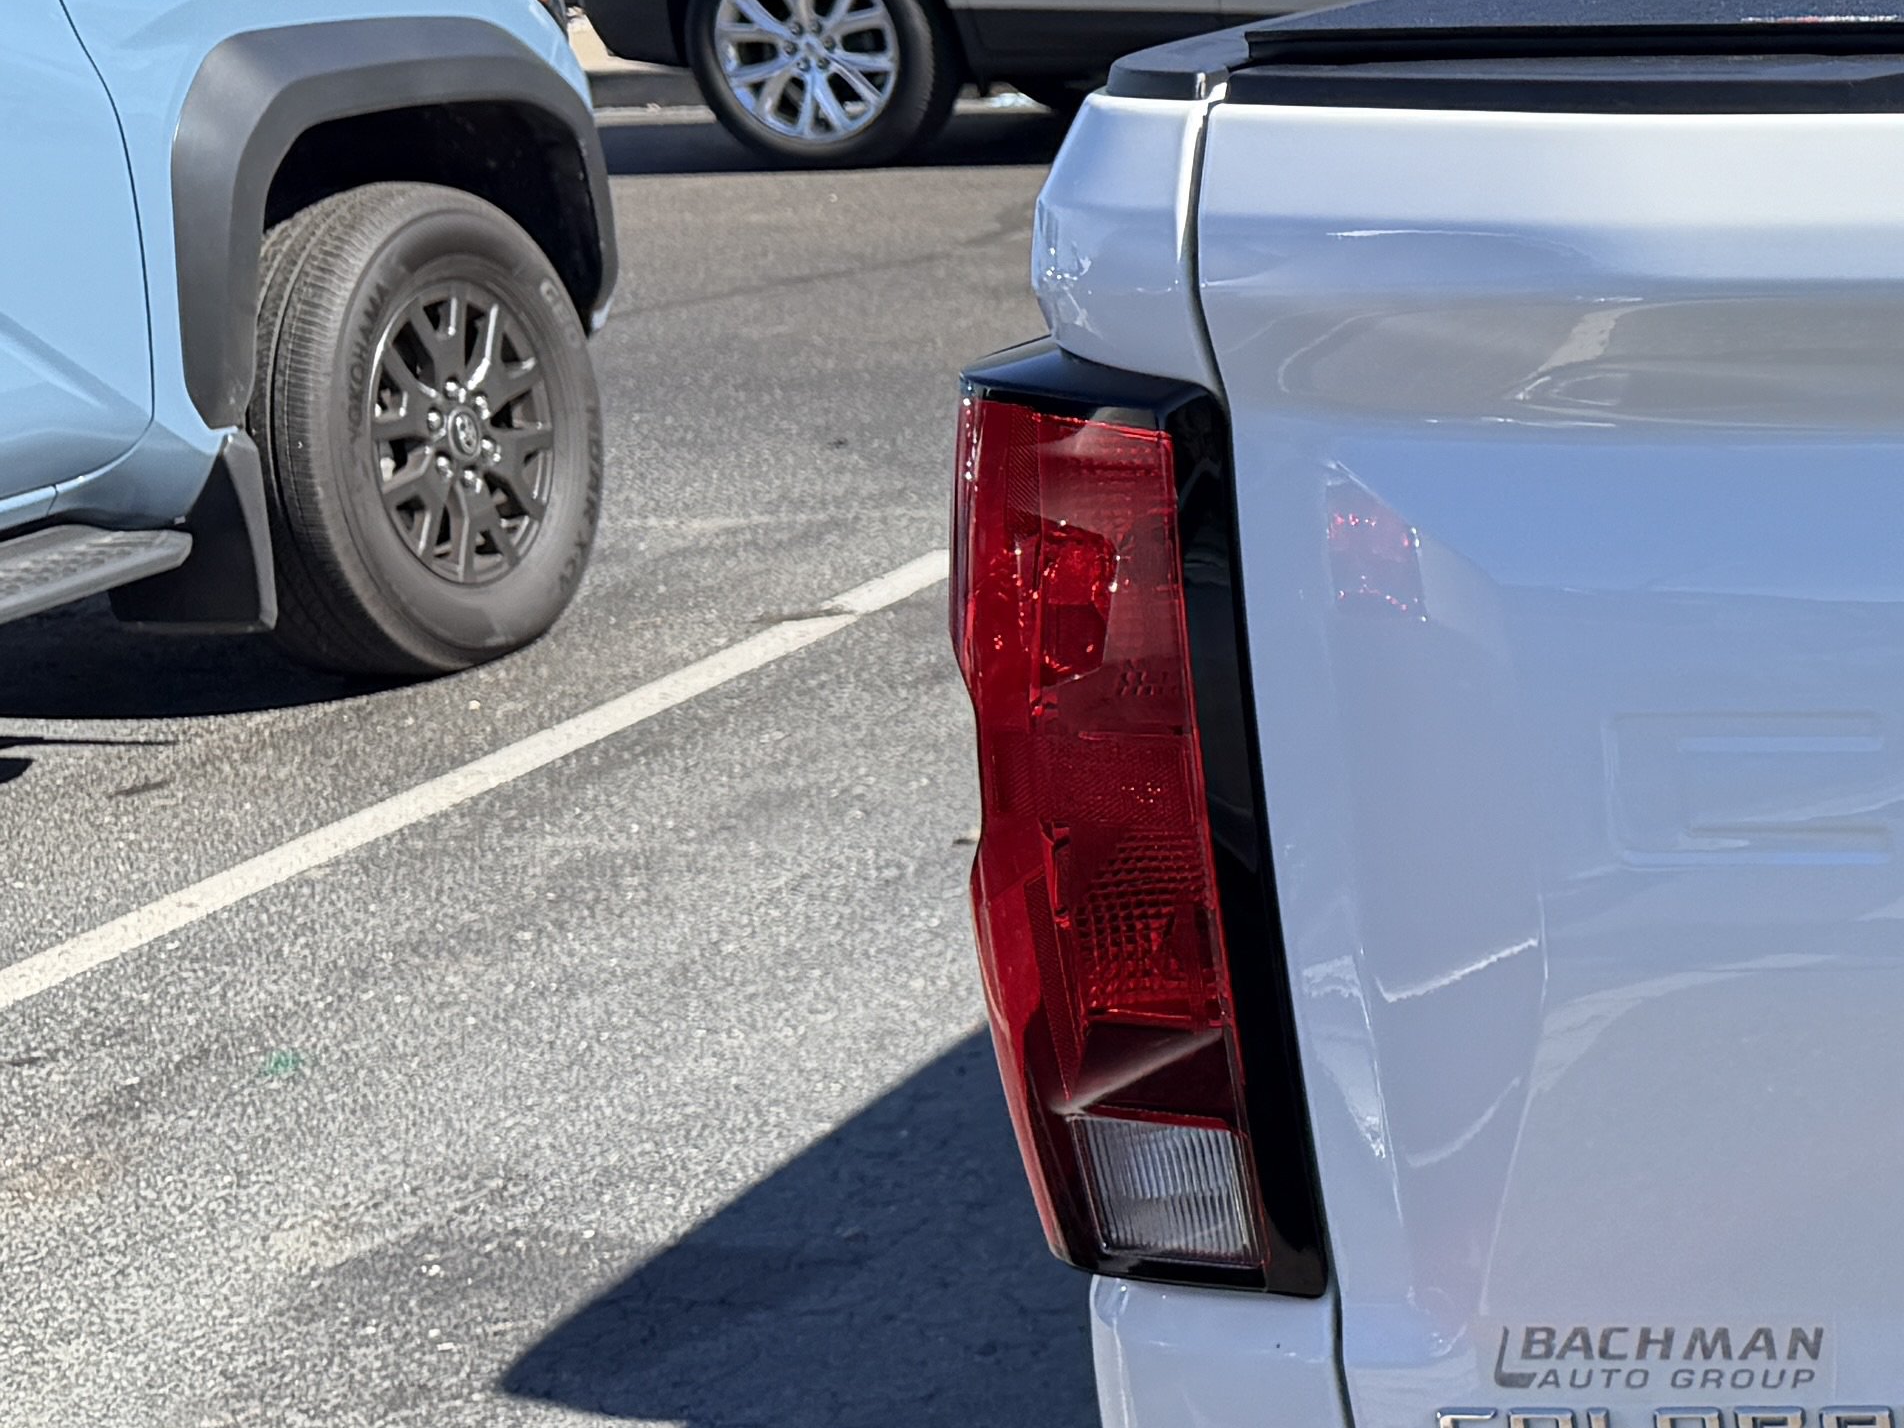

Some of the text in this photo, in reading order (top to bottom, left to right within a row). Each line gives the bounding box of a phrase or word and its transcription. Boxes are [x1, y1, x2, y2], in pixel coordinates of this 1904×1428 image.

[1520, 1325, 1824, 1360] BACHMAN
[1537, 1368, 1816, 1390] AUTO GROUP
